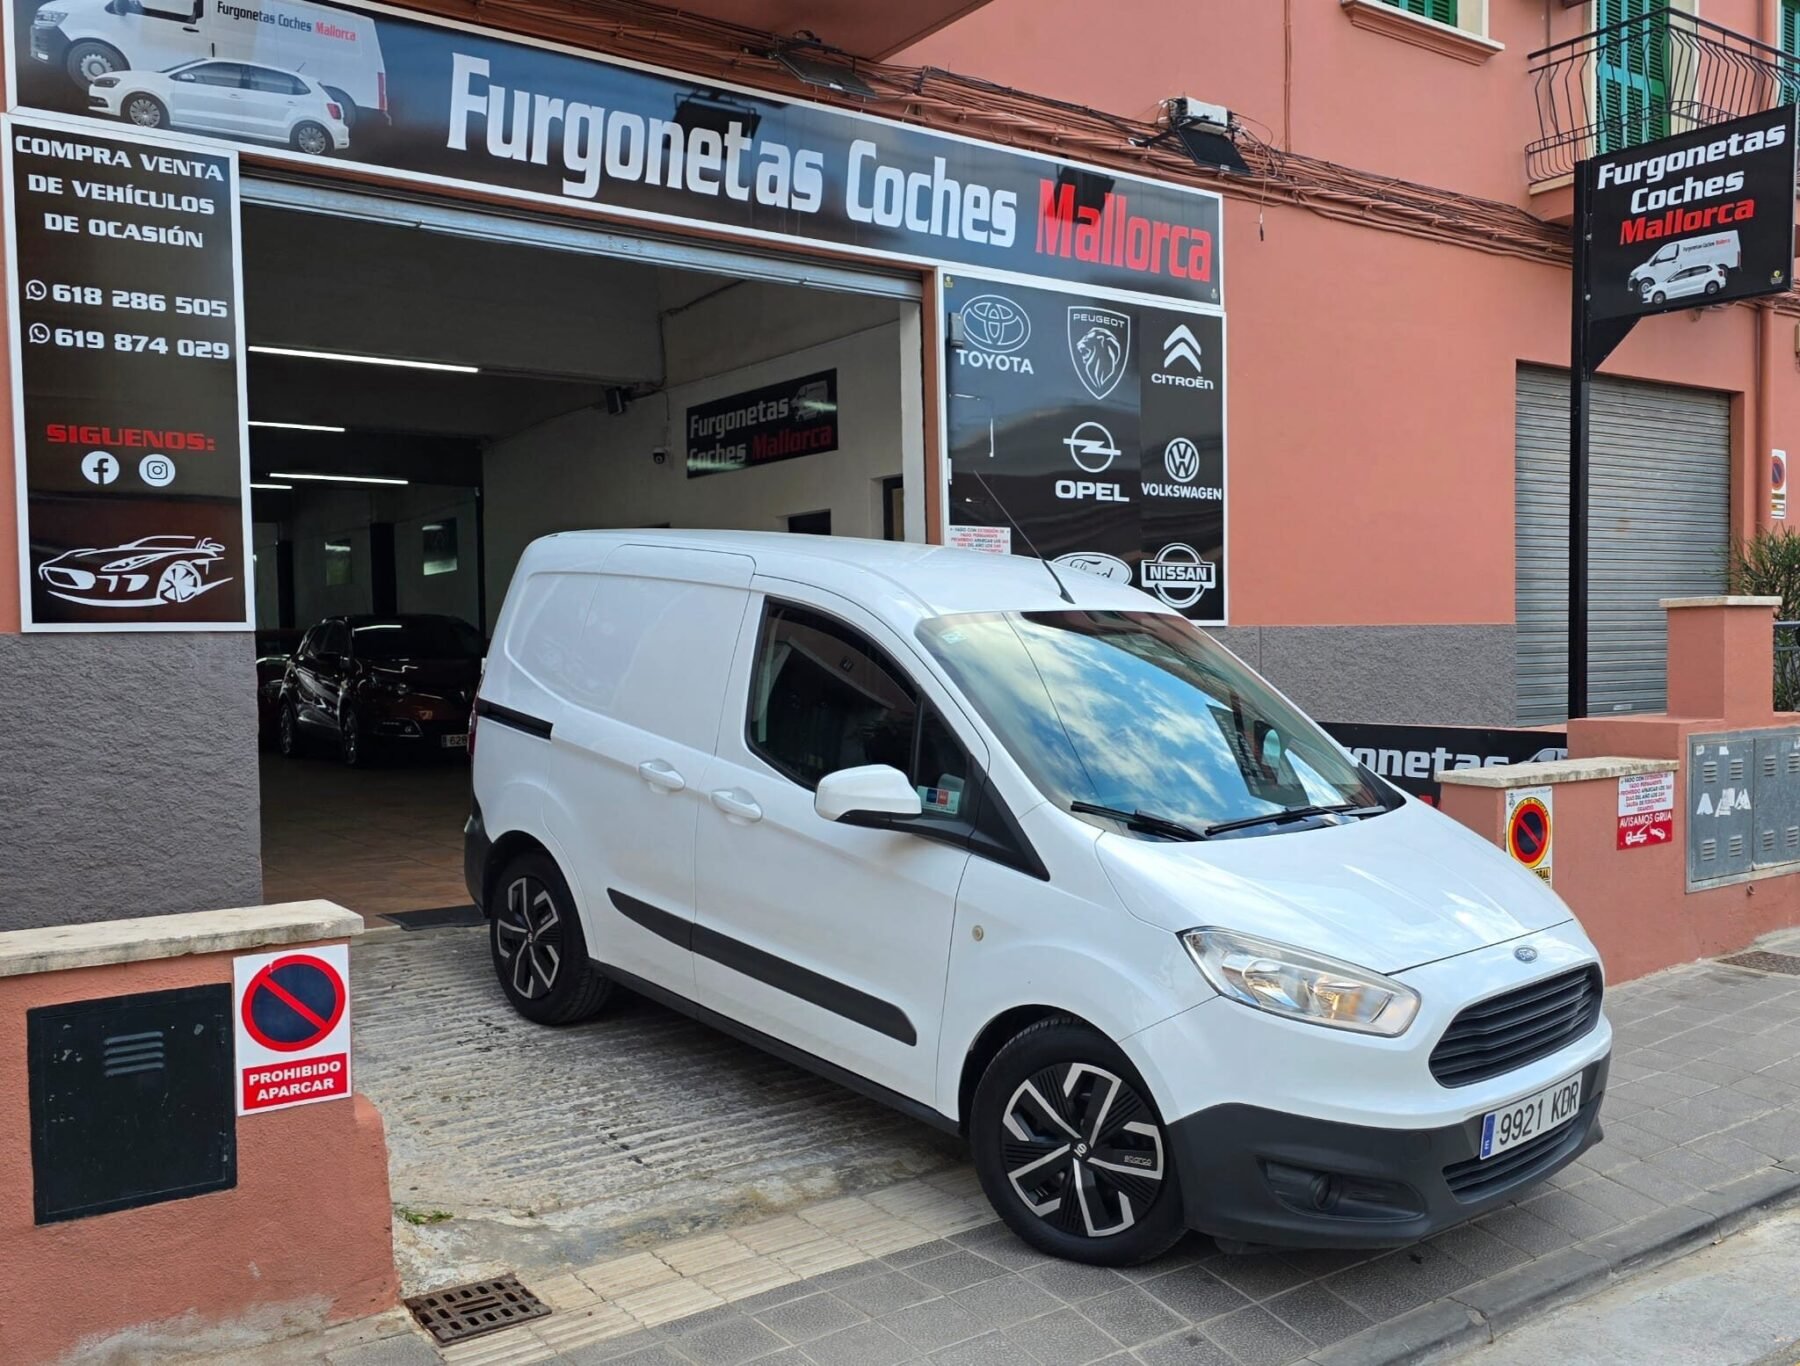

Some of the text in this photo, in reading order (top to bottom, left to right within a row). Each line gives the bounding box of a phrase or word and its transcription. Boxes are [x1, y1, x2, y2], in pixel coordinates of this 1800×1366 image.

[217, 1, 356, 41] Furgonetas Coches Mallorca
[15, 135, 224, 181] COMPRA VENTA
[446, 52, 1213, 282] Furgonetas Coches Mallorca
[1597, 124, 1786, 190] Furgonetas
[28, 174, 215, 215] DE VEHÍCULOS
[1630, 170, 1745, 215] Coches
[44, 212, 204, 248] DE OCASIÓN
[1619, 198, 1756, 246] Mallorca
[52, 284, 228, 318] 618 286 505
[1073, 312, 1126, 329] PEUGEOT
[54, 328, 230, 360] 619 874 029
[956, 348, 1034, 375] TOYOTA
[690, 397, 789, 440] Furgonetas
[46, 423, 216, 451] SIGUENOS:
[751, 425, 833, 461] Mallorca
[1055, 480, 1130, 502] OPEL
[1141, 482, 1223, 501] VOLKSWAGEN
[1149, 566, 1207, 581] NISSAN
[1619, 813, 1653, 828] AVISAMOS
[249, 1061, 341, 1086] PROHIBIDO
[257, 1078, 334, 1101] APARCAR
[1499, 1098, 1544, 1145] 9921
